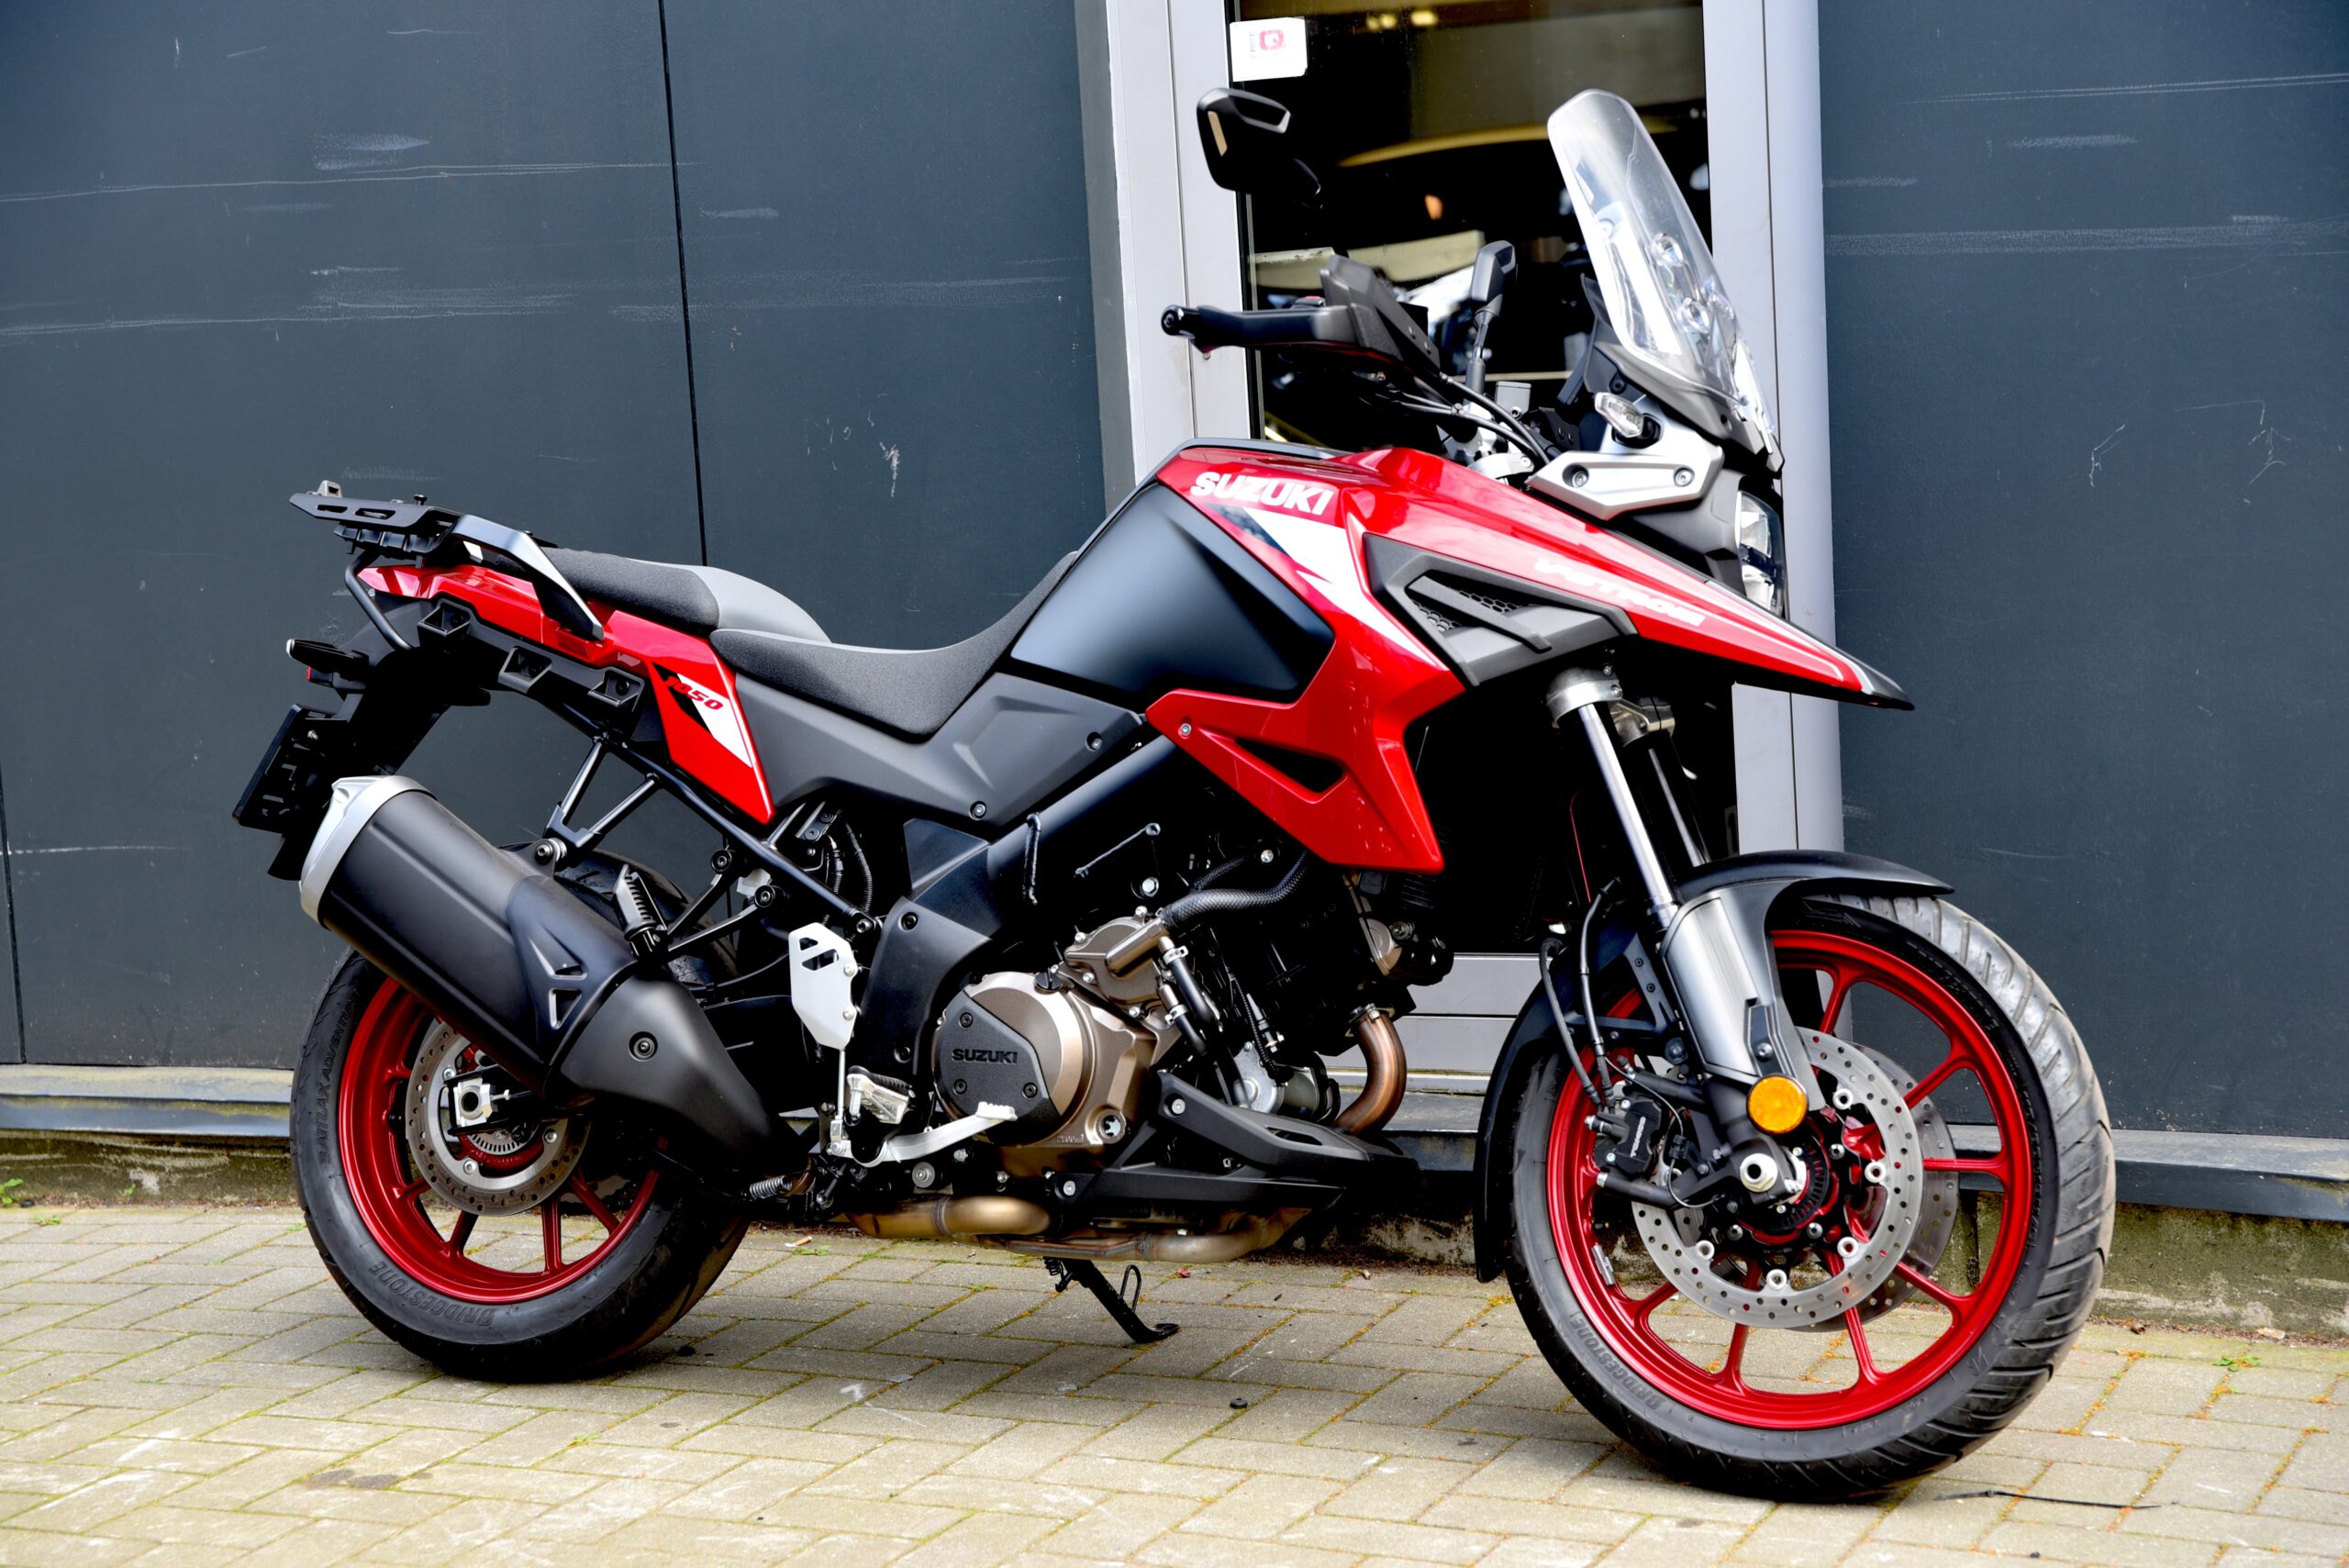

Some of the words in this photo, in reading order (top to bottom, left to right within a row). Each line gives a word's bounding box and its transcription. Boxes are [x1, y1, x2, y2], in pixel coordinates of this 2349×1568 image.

[1190, 472, 1335, 515] SUZUKI
[1534, 558, 1707, 627] V-STROM
[662, 676, 724, 710] 1050
[952, 1049, 1018, 1064] SUZUKI
[370, 1261, 496, 1327] BRIDGESTONE
[1569, 1318, 1663, 1410] BRIDGESTONE
